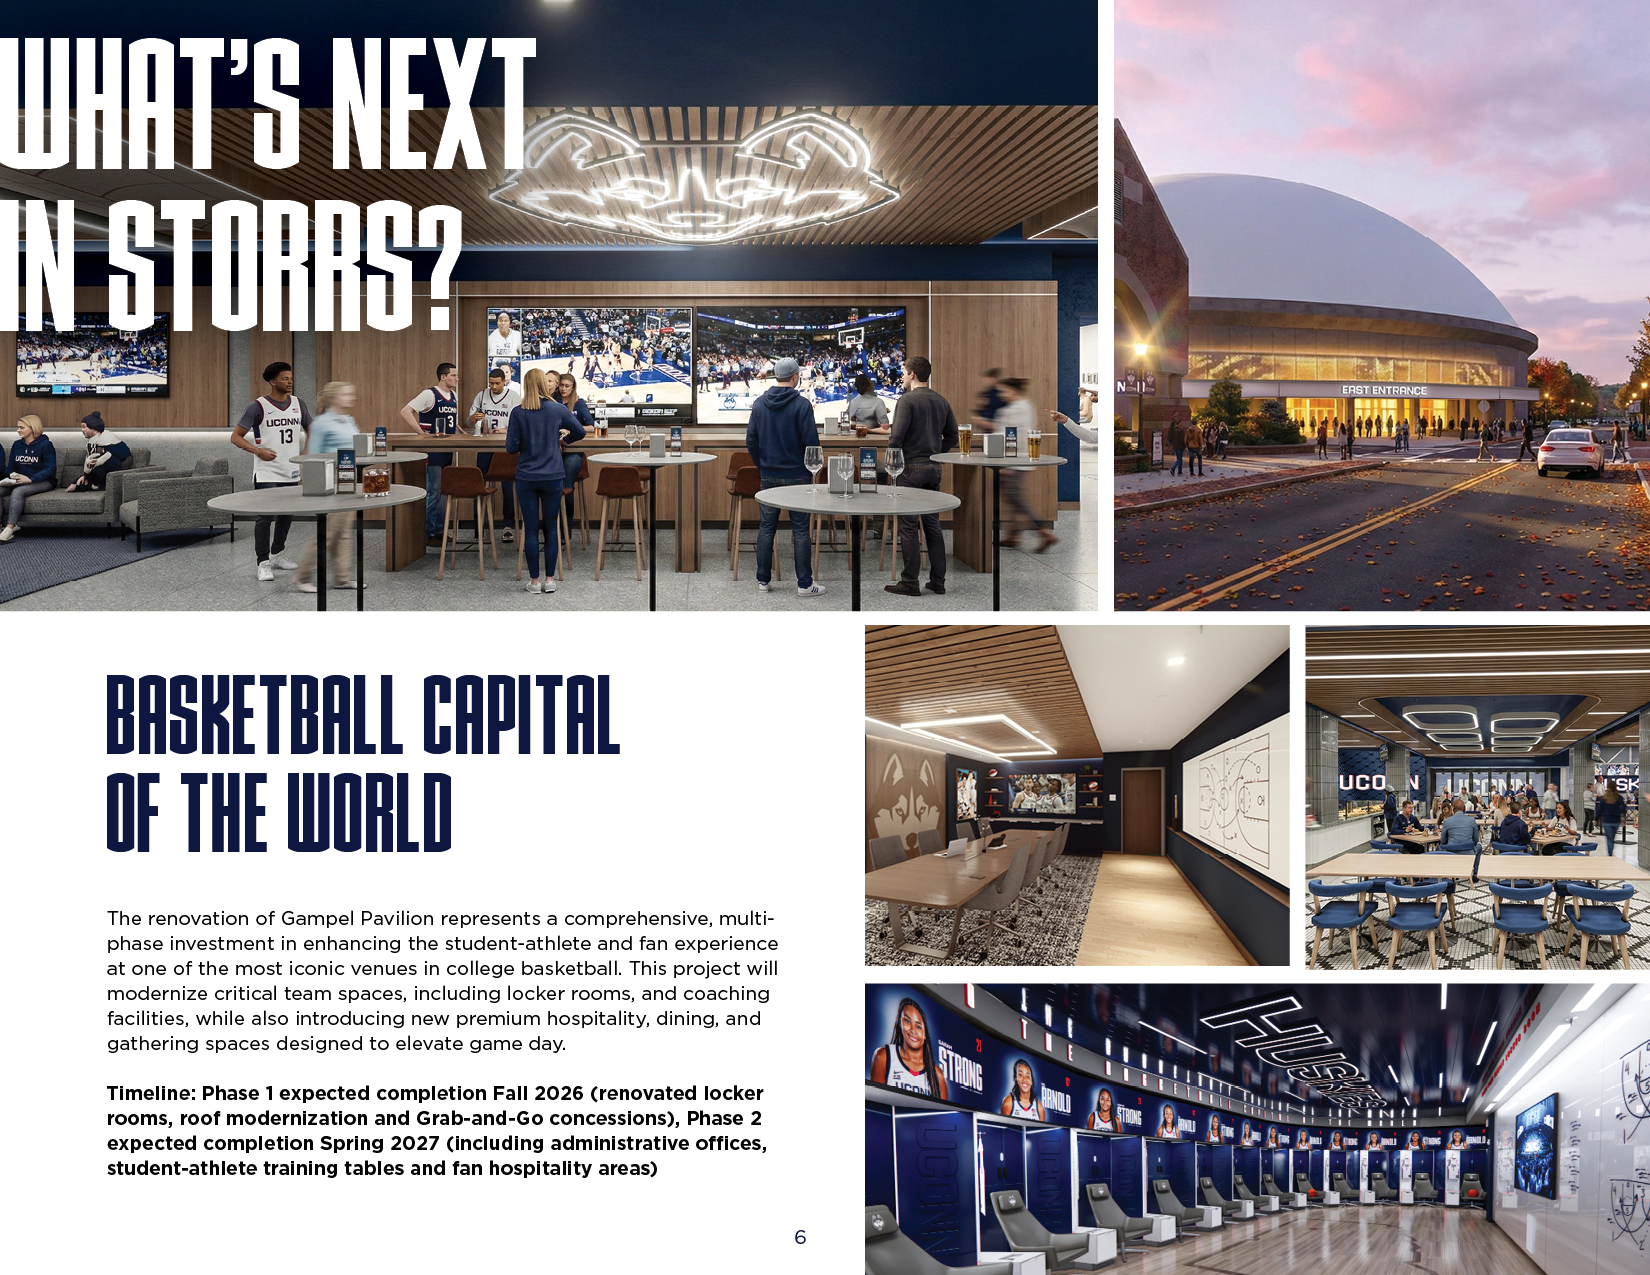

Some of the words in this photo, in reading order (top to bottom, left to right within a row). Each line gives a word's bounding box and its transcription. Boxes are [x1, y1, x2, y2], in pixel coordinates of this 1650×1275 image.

[1341, 385, 1370, 395] EAST
[1372, 385, 1428, 395] ENTRANCE
[266, 418, 301, 428] UCONN
[447, 415, 454, 428] 3
[279, 429, 293, 444] 13
[15, 455, 39, 463] UCONN
[1339, 774, 1419, 791] UCON
[938, 1045, 983, 1092] STRONG
[1041, 1085, 1071, 1114] ARNOLD
[1117, 1106, 1142, 1126] STRONG
